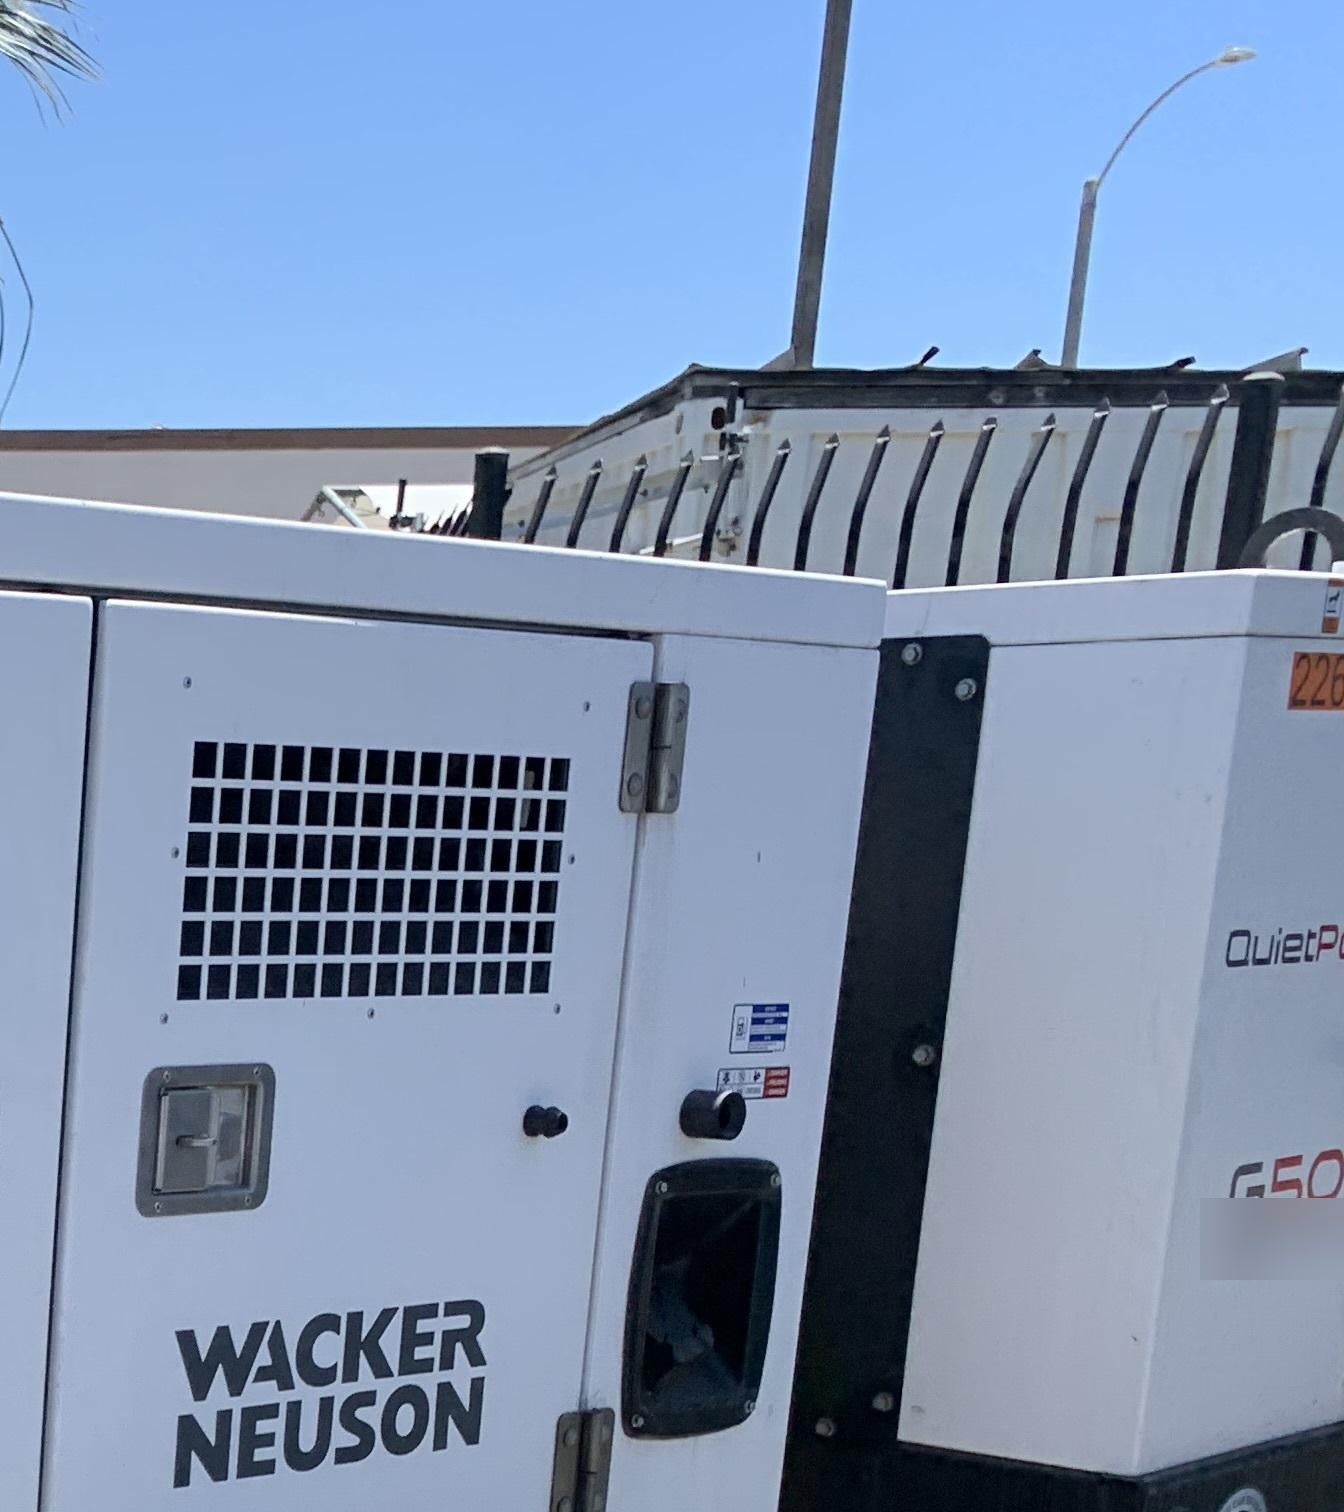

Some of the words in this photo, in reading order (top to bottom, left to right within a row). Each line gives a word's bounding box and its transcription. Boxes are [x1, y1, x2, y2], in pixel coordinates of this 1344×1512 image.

[1225, 924, 1344, 968] QuietP
[174, 1299, 488, 1402] WACKER
[173, 1376, 486, 1488] NEUSON
